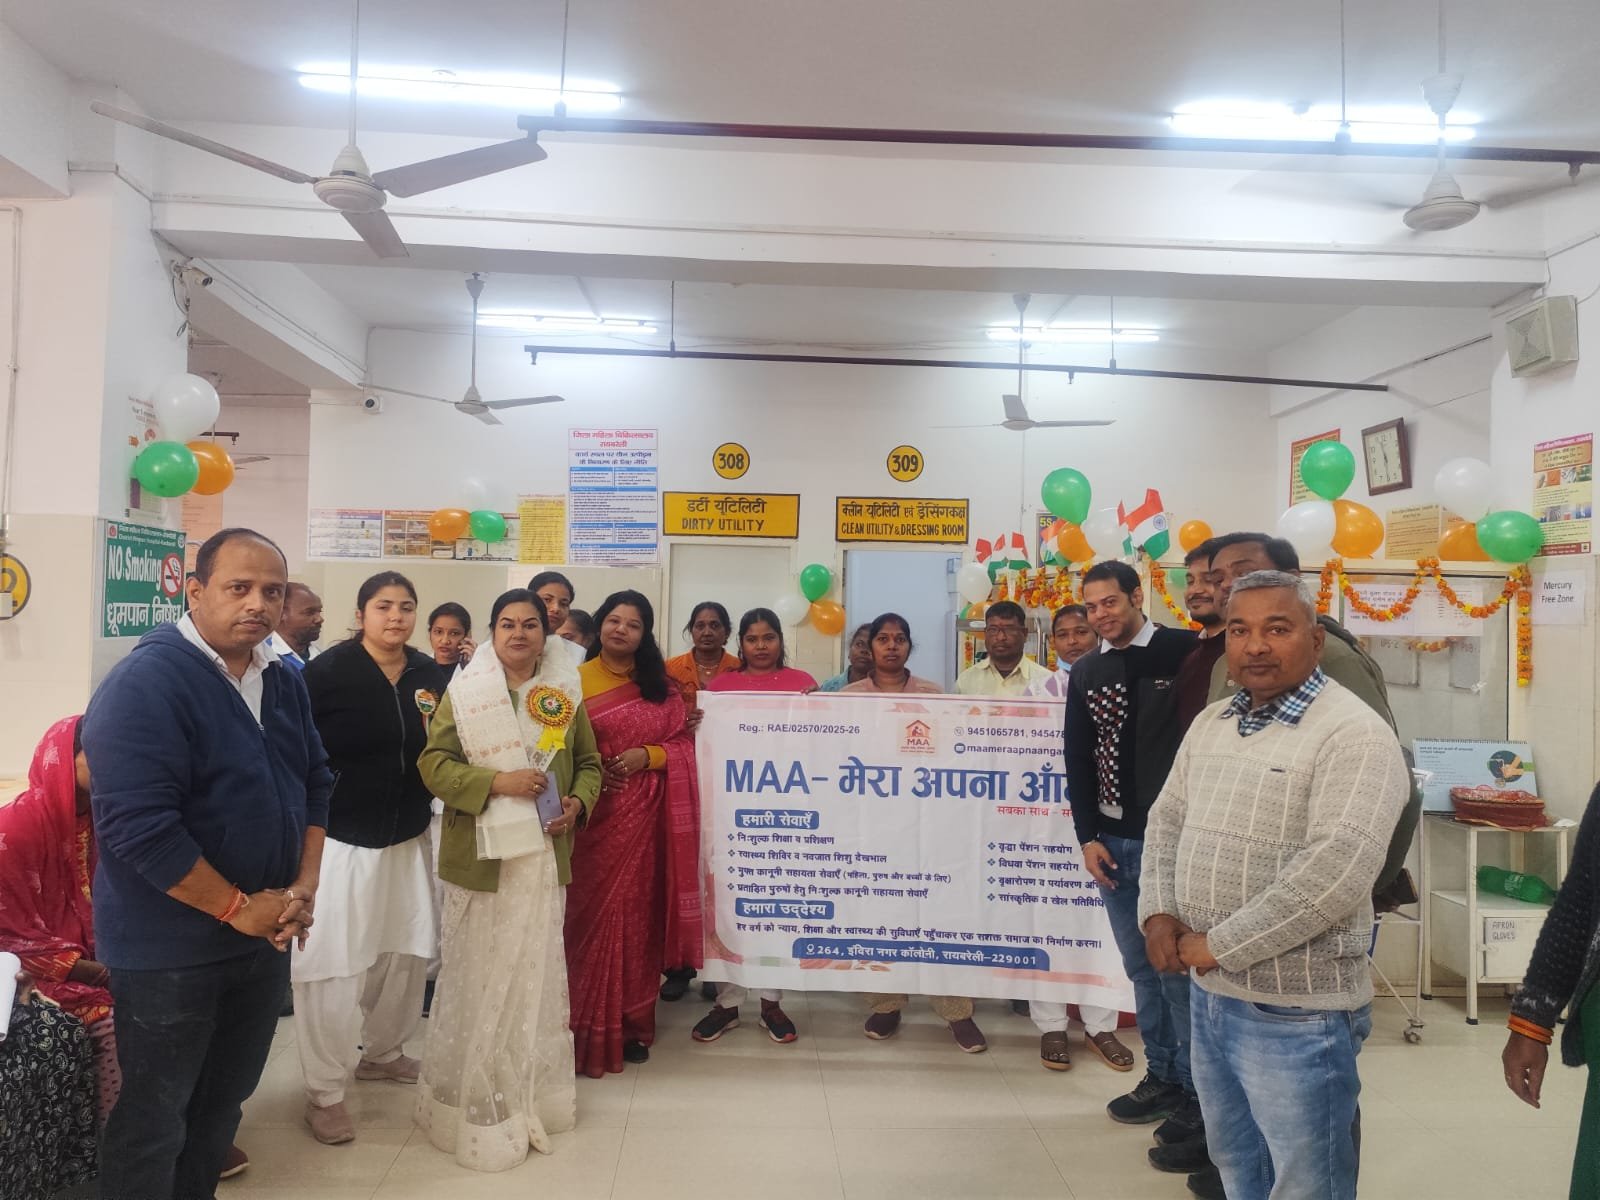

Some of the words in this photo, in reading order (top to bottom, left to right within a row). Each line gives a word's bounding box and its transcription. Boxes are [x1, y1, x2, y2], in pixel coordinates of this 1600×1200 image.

[718, 453, 745, 470] 308
[892, 454, 919, 473] 309
[686, 496, 710, 512] डर्टी
[714, 497, 768, 515] यूटिलिटी
[842, 501, 863, 517] क्लीन
[865, 501, 900, 519] यूटिलिटी
[682, 518, 714, 530] DIRTY
[718, 518, 765, 531] UTILITY
[841, 522, 864, 535] CLEAN
[942, 524, 965, 536] ROOM
[125, 546, 162, 592] Smoking
[1544, 582, 1572, 590] Mercury
[1541, 595, 1557, 603] Free
[1557, 594, 1574, 603] Zone
[152, 596, 181, 626] निषेध
[739, 723, 764, 734] Reg.:
[767, 724, 860, 734] RAE/02570/2025-26
[968, 727, 1029, 738] 9451065781,
[1031, 729, 1065, 739] 945478
[907, 738, 930, 746] MAA
[967, 745, 1065, 757] maameraapnaanga
[838, 755, 903, 798] मेरा
[911, 767, 1010, 801] अपना
[1018, 762, 1071, 803] आँ
[997, 805, 1026, 816] सबका
[1029, 806, 1049, 817] साथ
[740, 811, 775, 827] हमारी
[778, 811, 814, 829] सेवाएँ
[772, 833, 793, 844] शिक्षा
[795, 835, 801, 844] व
[803, 834, 835, 845] प्रशिक्षण
[1042, 843, 1073, 854] सहयोग
[794, 852, 800, 860] व
[802, 852, 831, 862] नवजात
[833, 851, 852, 865] शिशु
[855, 851, 888, 863] देखभाल
[998, 857, 1023, 869] विधवा
[1048, 861, 1080, 872] सहयोग
[756, 866, 783, 879] कानूनी
[785, 868, 816, 878] सहायता
[998, 875, 1037, 887] वृक्षारोपण
[1038, 878, 1045, 887] व
[1047, 878, 1082, 890] पर्यावरण
[793, 884, 806, 897] हेतु
[843, 885, 870, 898] कानूनी
[872, 888, 904, 898] सहायता
[998, 892, 1039, 906] सांस्कृतिक
[1041, 896, 1048, 905] व
[1050, 895, 1068, 906] खेल
[1071, 896, 1105, 908] गतिविधि
[742, 901, 776, 915] हमारा
[736, 922, 747, 932] हर
[750, 922, 761, 933] वर्ग
[763, 922, 775, 933] को
[803, 923, 824, 935] शिक्षा
[826, 924, 842, 935] और
[844, 926, 874, 937] स्वास्थ्य
[876, 926, 887, 937] की
[960, 932, 974, 941] एक
[1004, 934, 1030, 944] समाज
[1032, 935, 1043, 945] का
[1046, 935, 1073, 948] निर्माण
[817, 945, 845, 957] 264,
[876, 947, 897, 958] नगर
[900, 947, 939, 960] कॉलोनी,
